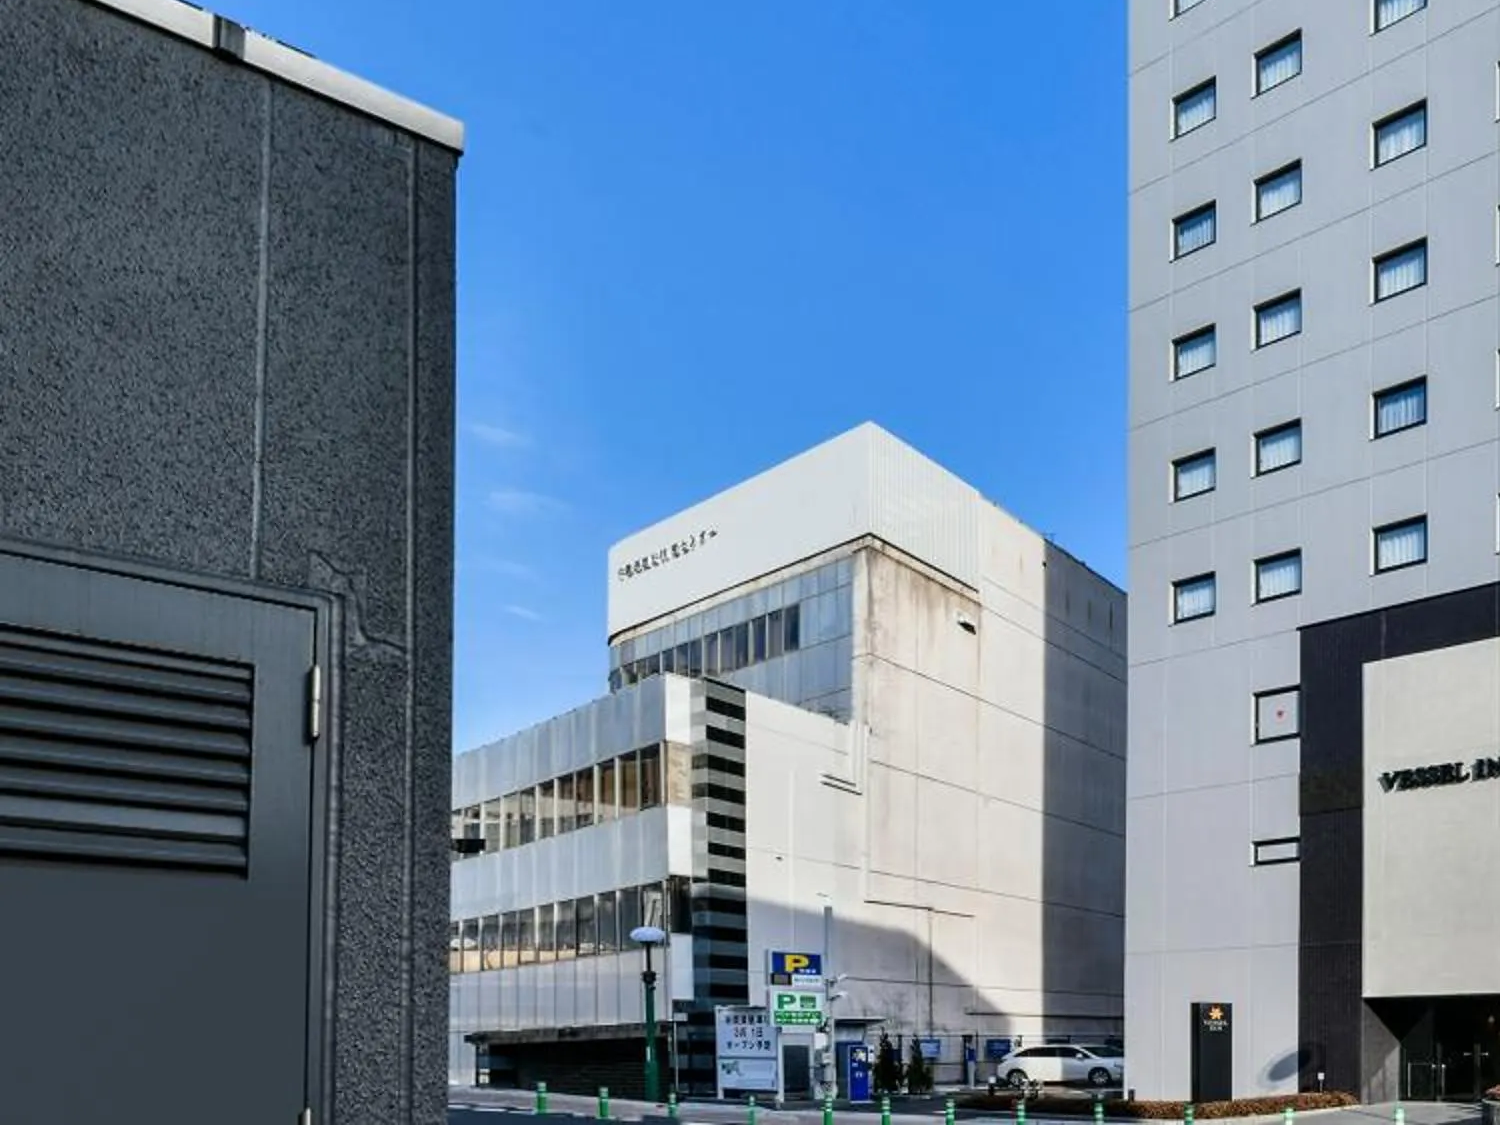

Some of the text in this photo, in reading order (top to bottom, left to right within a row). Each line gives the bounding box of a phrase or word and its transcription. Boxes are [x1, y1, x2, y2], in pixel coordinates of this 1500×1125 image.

[1378, 762, 1471, 793] VESSEL
[785, 955, 809, 972] P
[778, 994, 796, 1009] P
